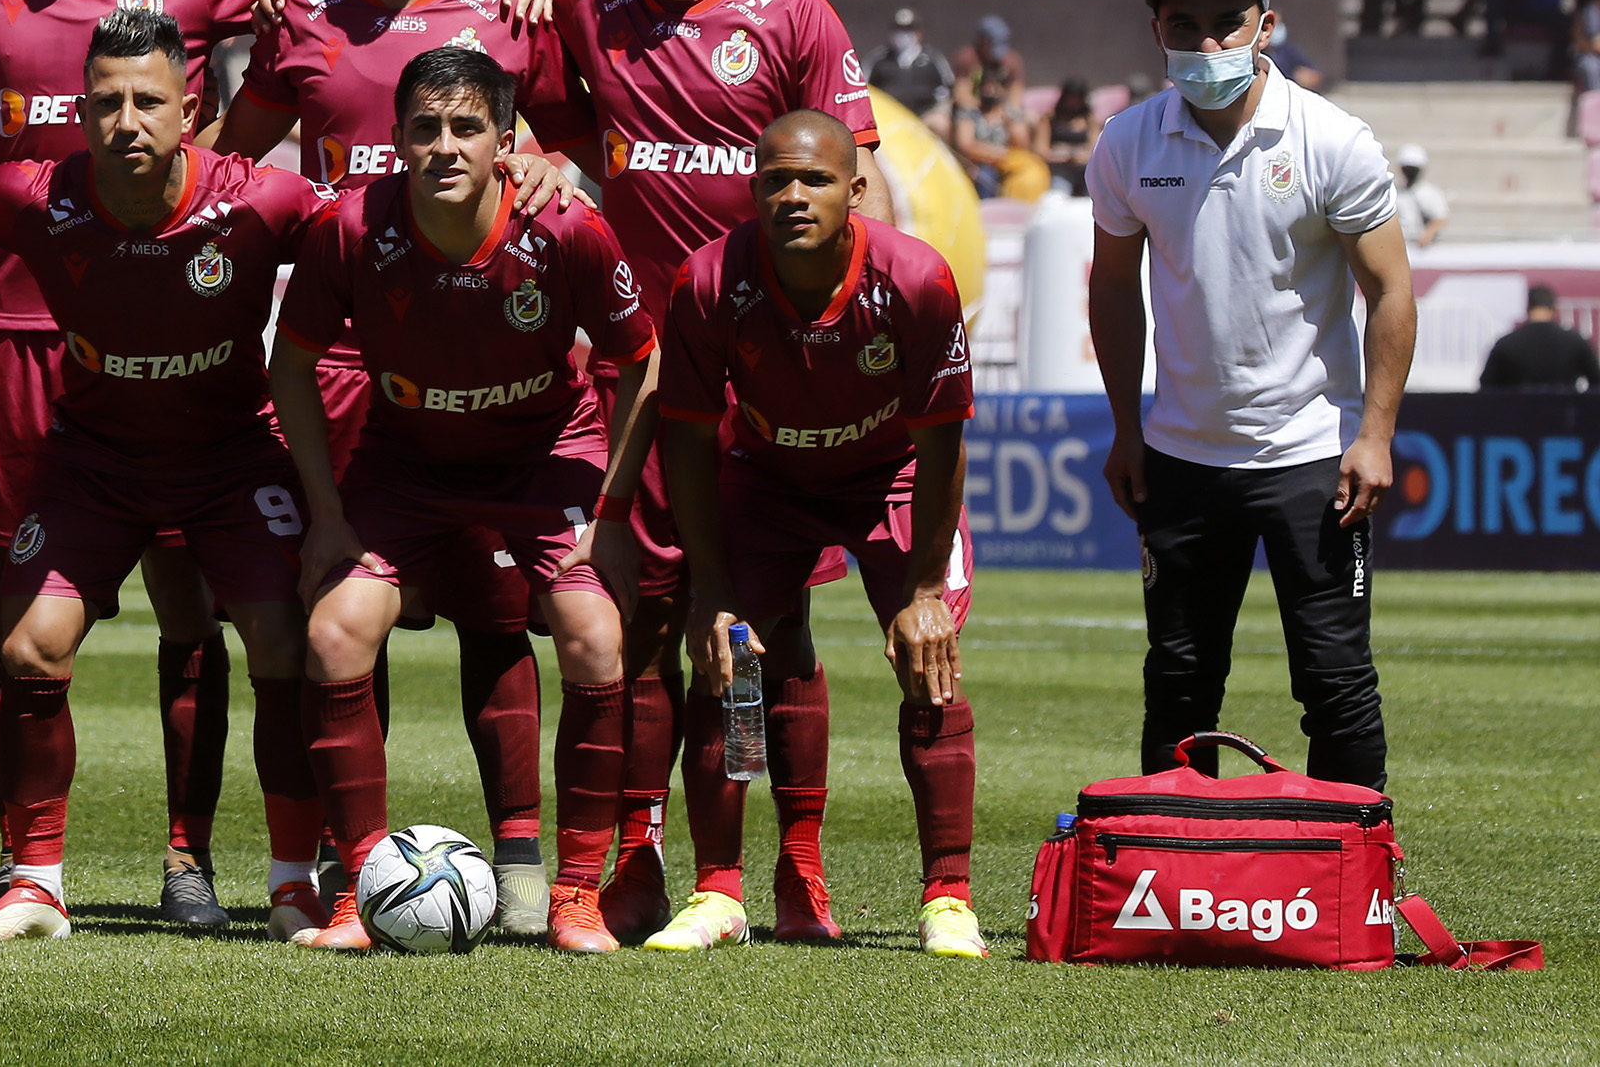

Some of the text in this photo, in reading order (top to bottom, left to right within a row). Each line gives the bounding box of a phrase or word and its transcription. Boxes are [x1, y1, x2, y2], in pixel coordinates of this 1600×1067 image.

[389, 19, 428, 33] MEDS
[667, 24, 702, 40] MEDS
[1140, 175, 1185, 188] macron
[131, 244, 170, 257] MEDS
[451, 275, 490, 290] MEDS
[802, 332, 841, 344] MEDS
[104, 339, 234, 380] BETANO
[424, 371, 554, 413] BETANO
[776, 397, 900, 448] BETANO
[963, 439, 1093, 536] EDS
[254, 484, 303, 536] 9
[1352, 531, 1366, 598] macron
[1179, 887, 1319, 942] Bagó
